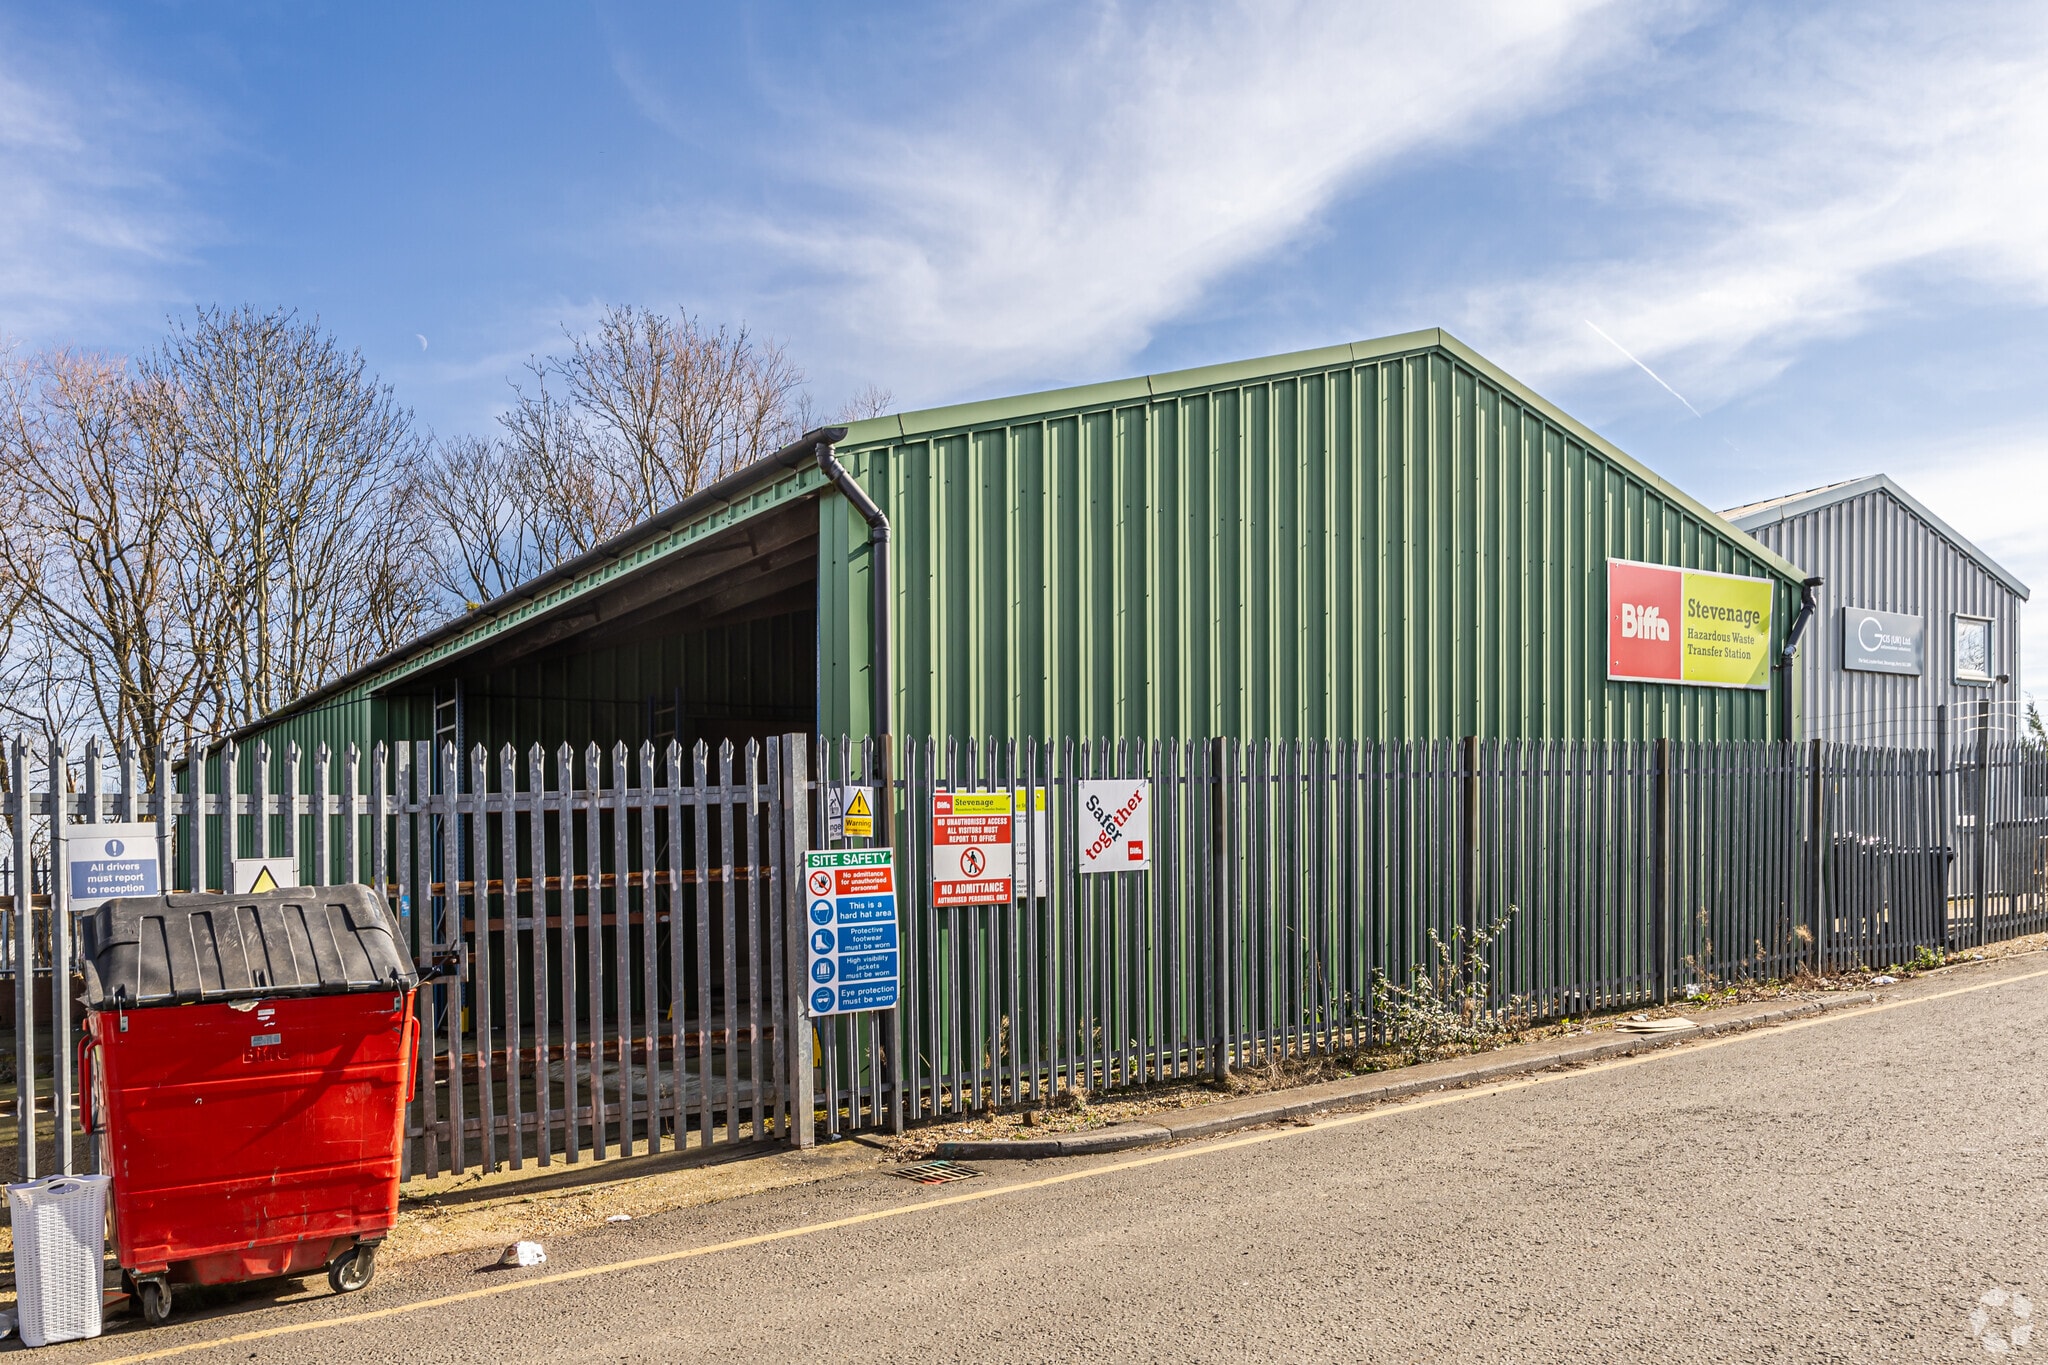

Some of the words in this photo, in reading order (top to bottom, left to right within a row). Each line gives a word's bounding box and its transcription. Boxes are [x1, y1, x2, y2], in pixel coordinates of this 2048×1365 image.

[1688, 598, 1760, 629] Stevenage
[1622, 602, 1670, 642] Biffa
[1687, 628, 1730, 643] Hazardous
[1732, 632, 1755, 645] Waste
[1687, 644, 1723, 657] Transfer
[1724, 647, 1752, 660] Station
[955, 798, 994, 807] Stevenage
[1086, 794, 1122, 842] Safer
[846, 820, 871, 828] Warning
[979, 834, 996, 842] OFFICE
[812, 854, 838, 866] SITE
[843, 852, 886, 865] SAFETY
[90, 863, 104, 872] All
[106, 862, 140, 871] drivers
[87, 874, 112, 883] must
[114, 873, 144, 883] report
[86, 886, 98, 894] to
[100, 884, 144, 894] reception
[942, 884, 952, 895] NO
[956, 882, 1004, 894] ADMITTANCE
[938, 896, 967, 904] AUTHORISED
[968, 894, 995, 902] PERSONNEL
[856, 964, 880, 972] jackets
[841, 989, 855, 998] Eye
[858, 986, 894, 996] protection
